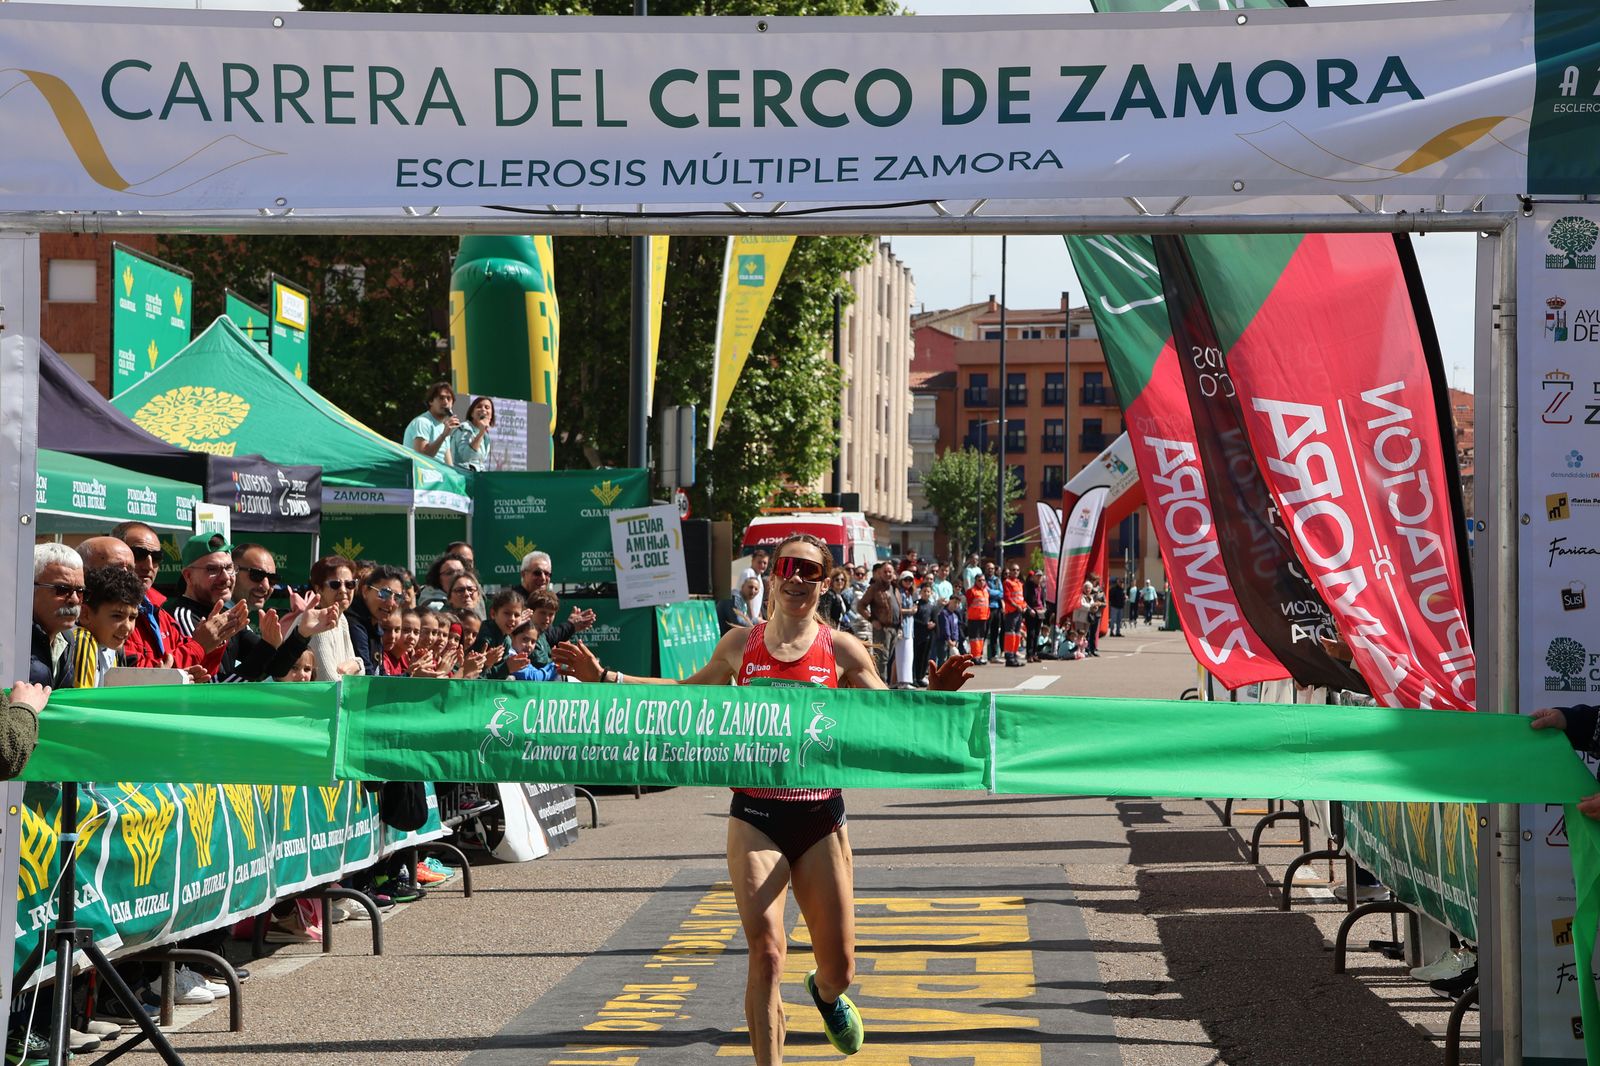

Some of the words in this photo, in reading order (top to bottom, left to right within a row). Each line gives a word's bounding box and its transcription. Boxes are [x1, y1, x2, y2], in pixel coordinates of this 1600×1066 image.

[101, 59, 467, 127] CARRERA
[495, 68, 628, 128] DEL
[649, 68, 913, 129] CERCO
[941, 66, 1032, 126] DE
[1057, 55, 1425, 122] ZAMORA
[397, 157, 647, 188] ESCLEROSIS
[662, 151, 860, 188] MÚLTIPLE
[873, 149, 1064, 183] ZAMORA
[334, 490, 385, 502] ZAMORA
[494, 506, 515, 514] CAJA
[517, 505, 547, 514] RURAL
[580, 509, 602, 518] CAJA
[628, 518, 664, 536] LLEVAR
[634, 537, 646, 552] MI
[647, 534, 670, 551] HIJA
[644, 551, 669, 568] COLE
[494, 565, 515, 574] CAJA
[1564, 593, 1583, 606] Susi
[522, 698, 600, 735] CARRERA
[605, 698, 631, 735] del
[634, 699, 693, 737] CERCO
[696, 699, 713, 737] de
[717, 701, 792, 737] ZAMORA
[522, 741, 577, 762] Zamora
[581, 745, 620, 762] cerca
[622, 741, 640, 762] de
[643, 741, 657, 762] la
[660, 741, 729, 763] Esclerosis
[733, 741, 791, 767] Múltiple
[283, 837, 307, 858] RURAL
[181, 883, 201, 905] CAJA
[201, 871, 227, 897] RURAL
[111, 903, 133, 924] CAJA
[134, 892, 171, 918] RURAL
